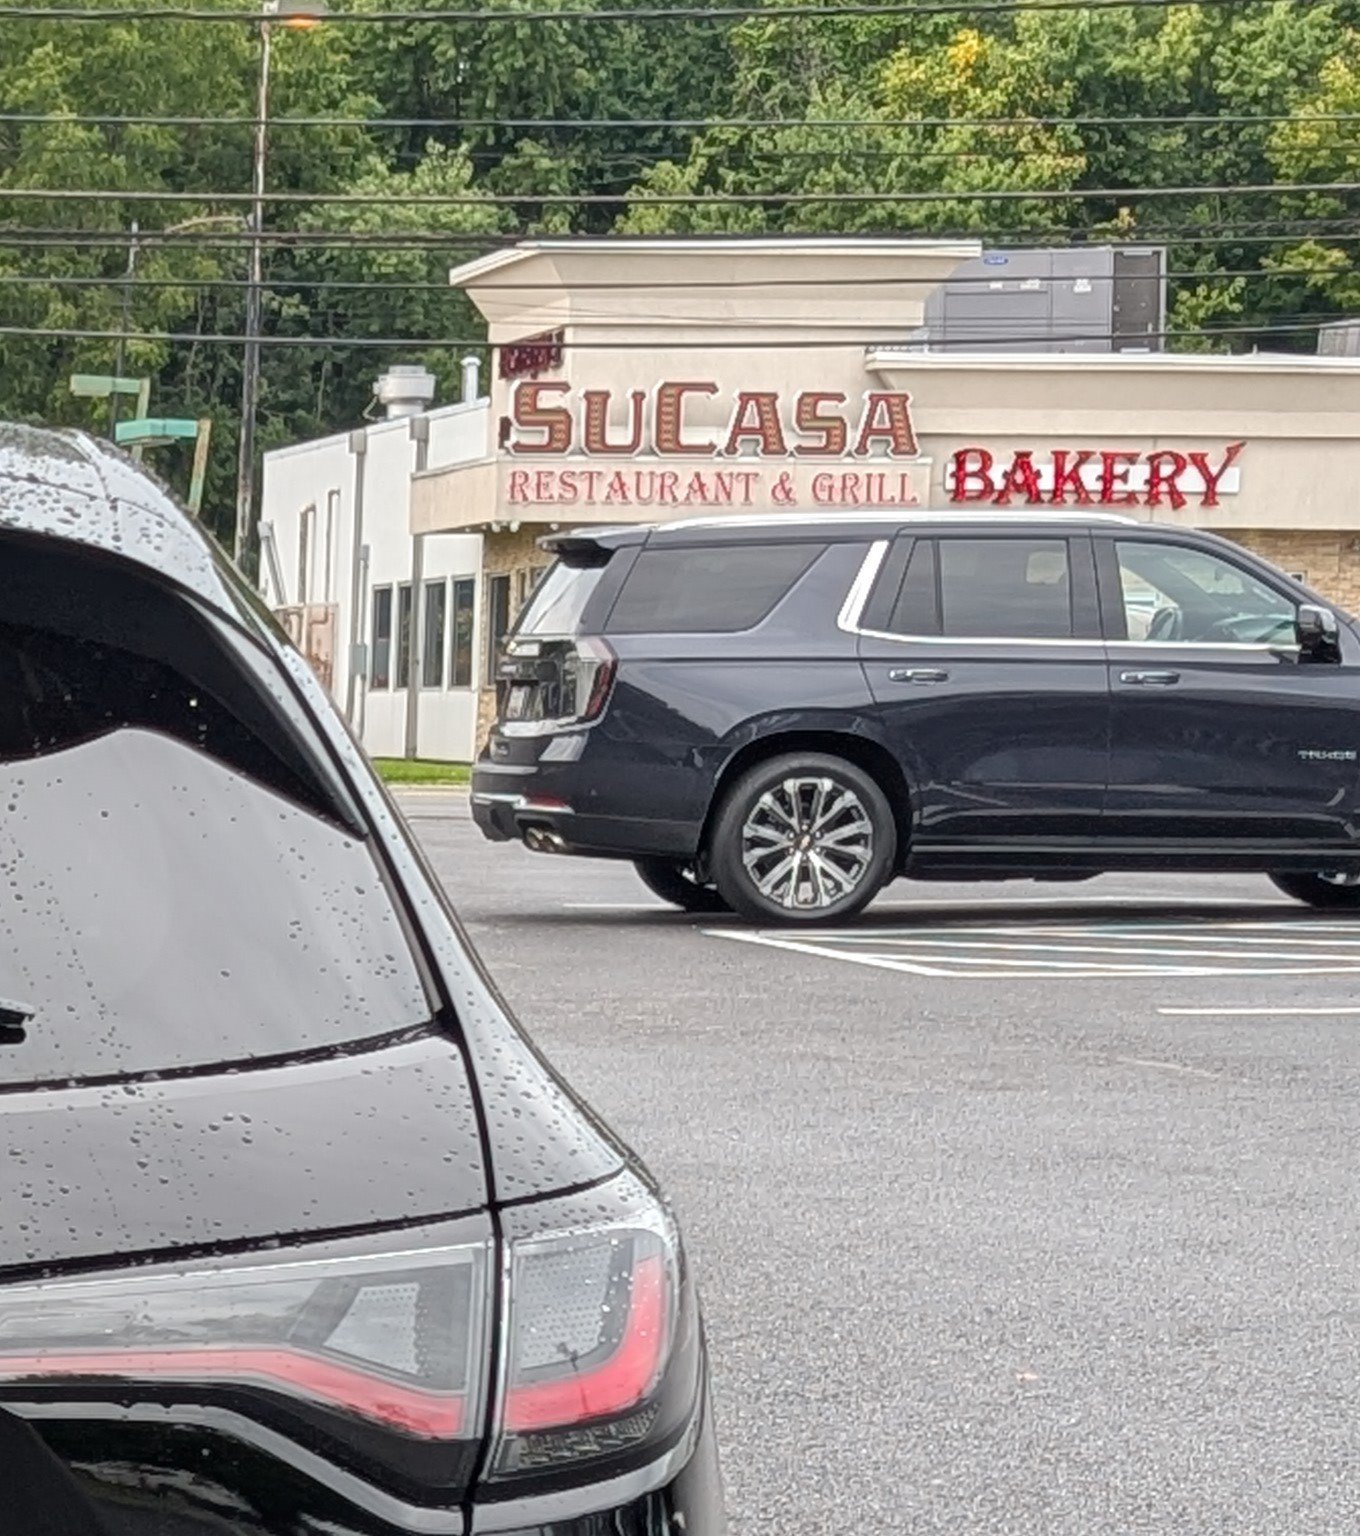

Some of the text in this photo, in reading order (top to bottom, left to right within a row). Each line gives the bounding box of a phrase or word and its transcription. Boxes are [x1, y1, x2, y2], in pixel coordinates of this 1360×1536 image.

[508, 470, 920, 505] RESTAURANT & GRILL
[950, 442, 1247, 510] BAKERY
